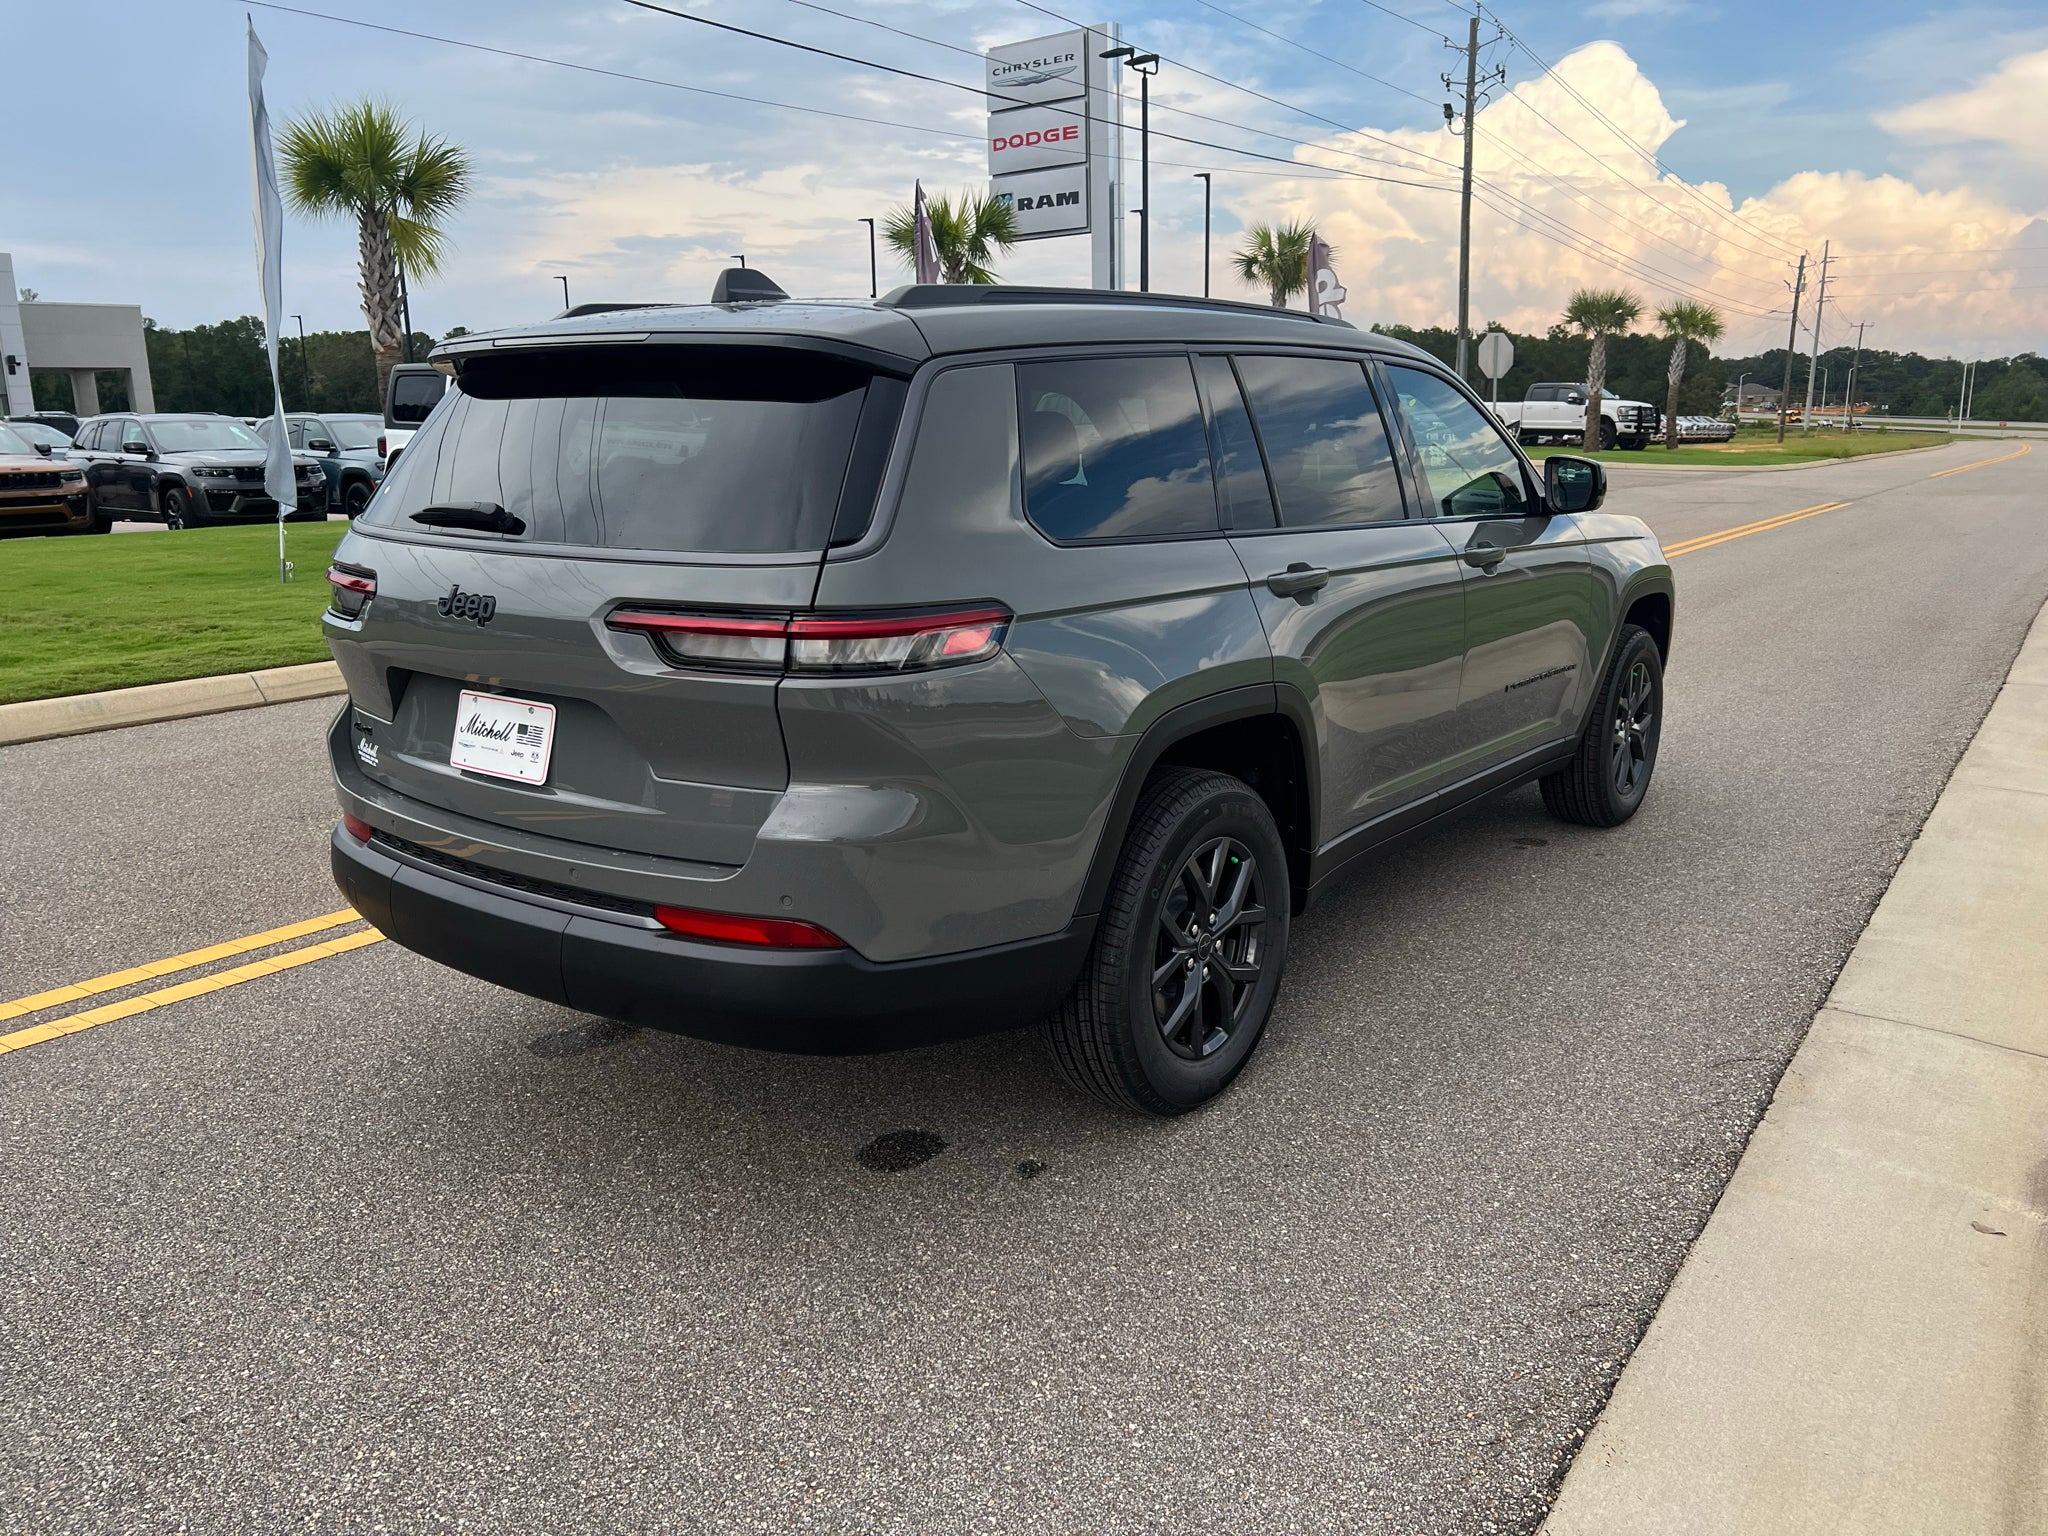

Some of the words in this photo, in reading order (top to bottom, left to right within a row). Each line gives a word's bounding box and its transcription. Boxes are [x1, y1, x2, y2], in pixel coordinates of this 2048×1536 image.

[992, 53, 1075, 76] CHRYSLER
[993, 125, 1079, 152] DODGE
[1017, 190, 1080, 212] RAM
[437, 584, 496, 627] Jeep
[460, 712, 517, 742] Mitchell
[510, 749, 525, 759] Jeep
